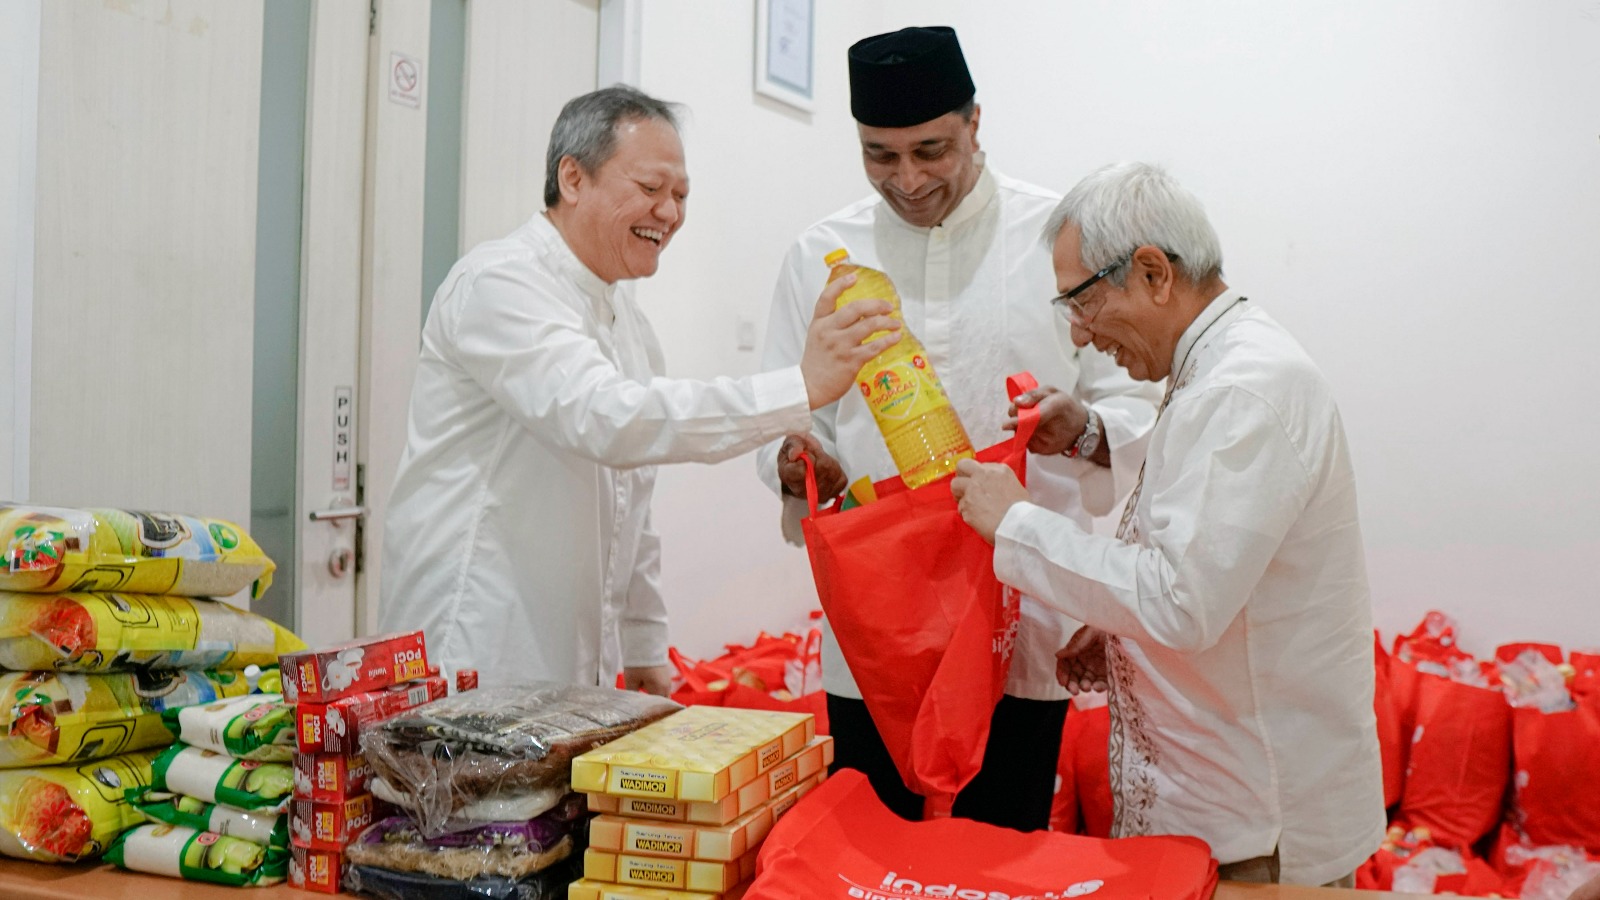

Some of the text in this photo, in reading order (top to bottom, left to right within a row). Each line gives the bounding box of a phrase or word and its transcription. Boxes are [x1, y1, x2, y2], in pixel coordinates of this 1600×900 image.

[871, 380, 916, 408] TROPICAL
[336, 397, 348, 463] PUSH
[394, 648, 422, 664] POCI
[299, 665, 308, 692] POCI
[313, 715, 321, 742] POCI
[317, 762, 326, 789] POCI
[621, 779, 666, 793] WADIMOR
[632, 801, 675, 815] WADIMOR
[315, 812, 323, 839] POCI
[347, 812, 372, 831] POCI
[636, 839, 682, 854] WADIMOR
[309, 856, 317, 882] POCI
[630, 869, 675, 883] WADIMOR
